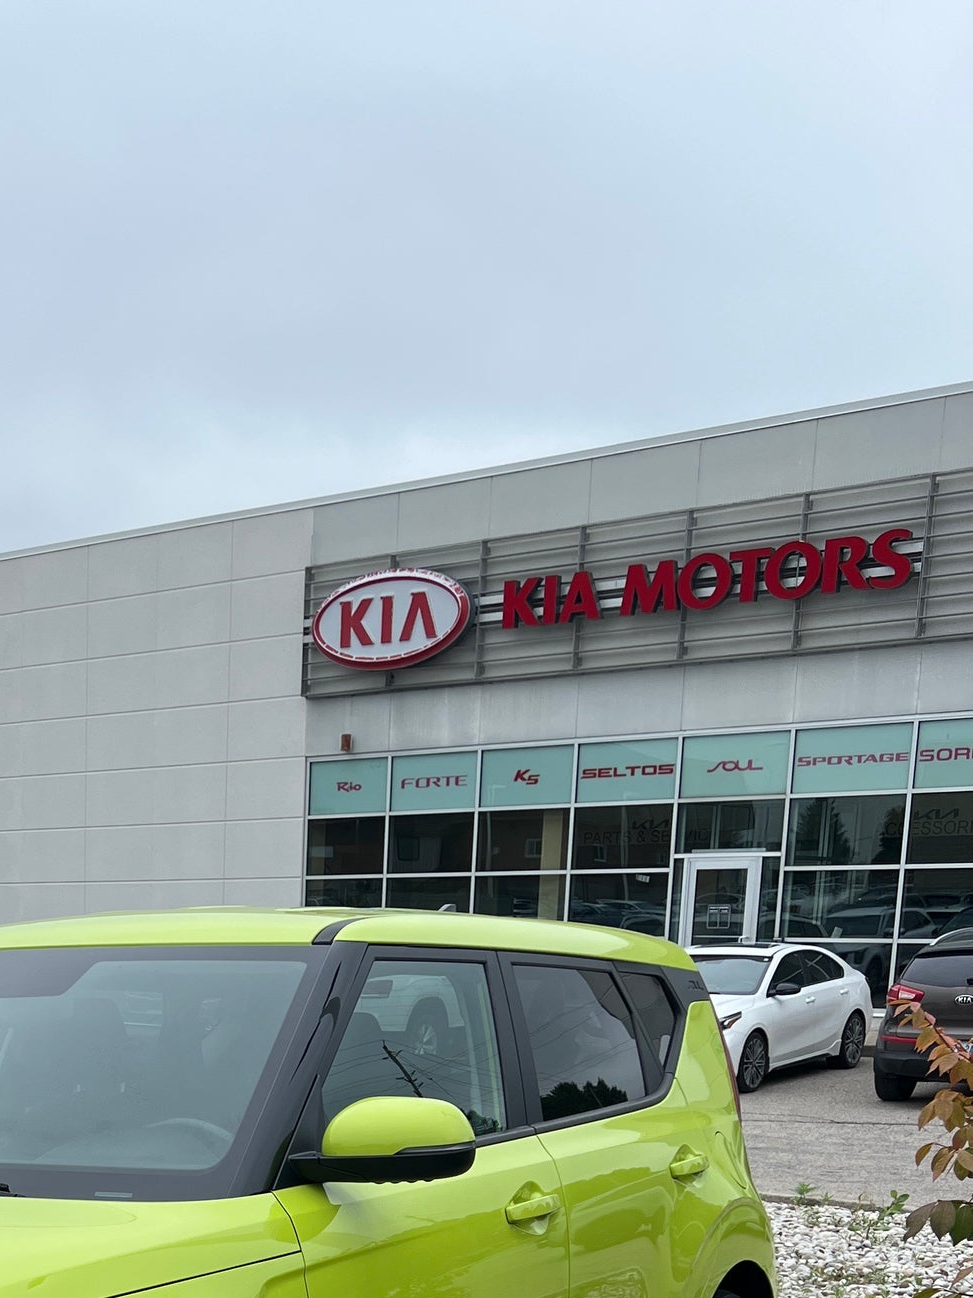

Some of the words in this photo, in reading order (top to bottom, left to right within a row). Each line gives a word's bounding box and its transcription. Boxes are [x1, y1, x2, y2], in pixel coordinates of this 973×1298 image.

[502, 571, 603, 629] KIA
[619, 528, 914, 617] MOTORS
[338, 591, 438, 649] KIA
[797, 752, 909, 767] SPORTAGE
[919, 747, 973, 762] SOR
[580, 764, 676, 779] SELTOS
[707, 759, 763, 773] SOUL
[400, 774, 468, 790] FORTE
[513, 769, 540, 785] K5
[336, 781, 362, 793] Rio
